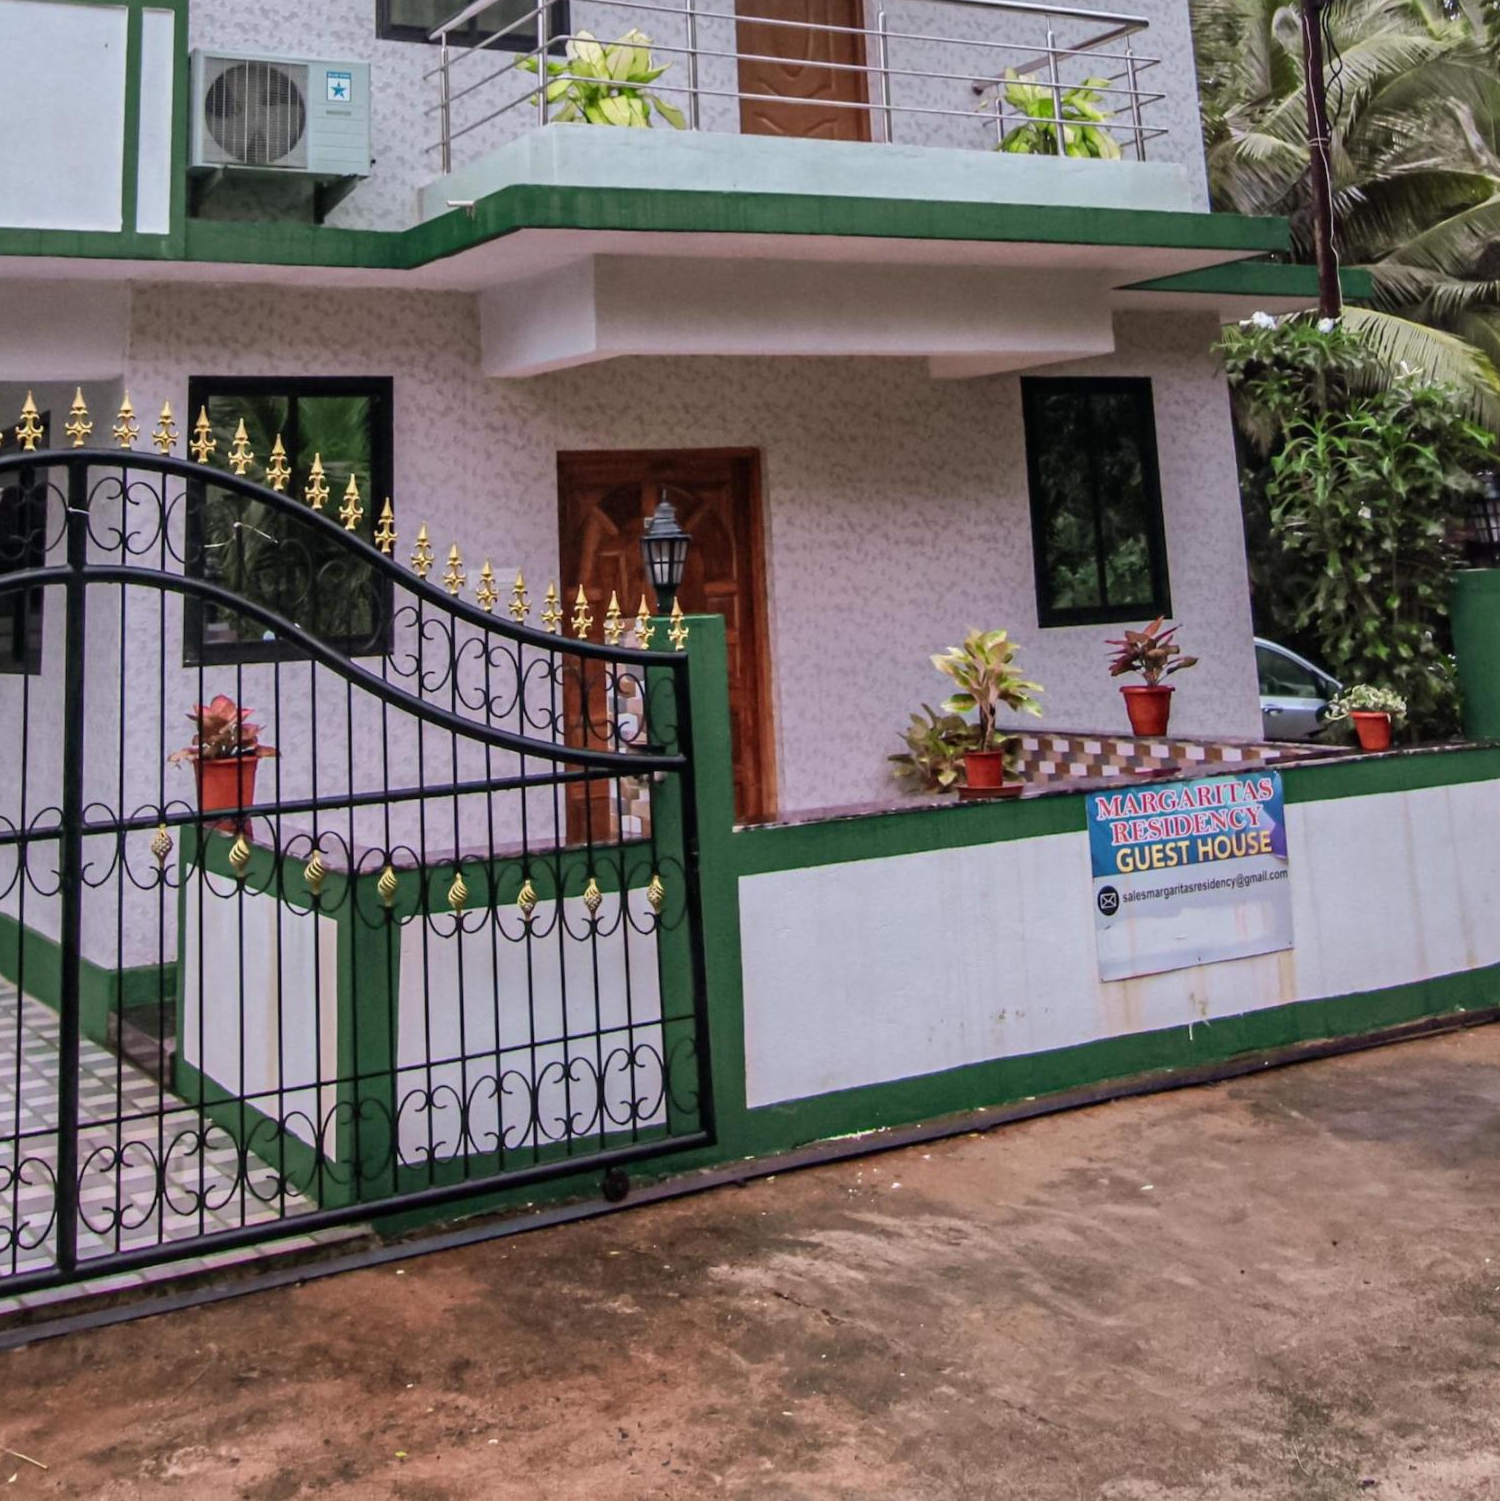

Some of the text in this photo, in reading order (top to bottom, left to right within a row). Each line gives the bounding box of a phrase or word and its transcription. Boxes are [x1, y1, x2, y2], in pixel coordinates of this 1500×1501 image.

[1096, 777, 1274, 821] MARGARITAS
[1111, 804, 1263, 846] RESIDENCY
[1116, 830, 1273, 874] GUEST HOUSE
[1122, 869, 1288, 904] salesmargaritasresidency@gmail.com
